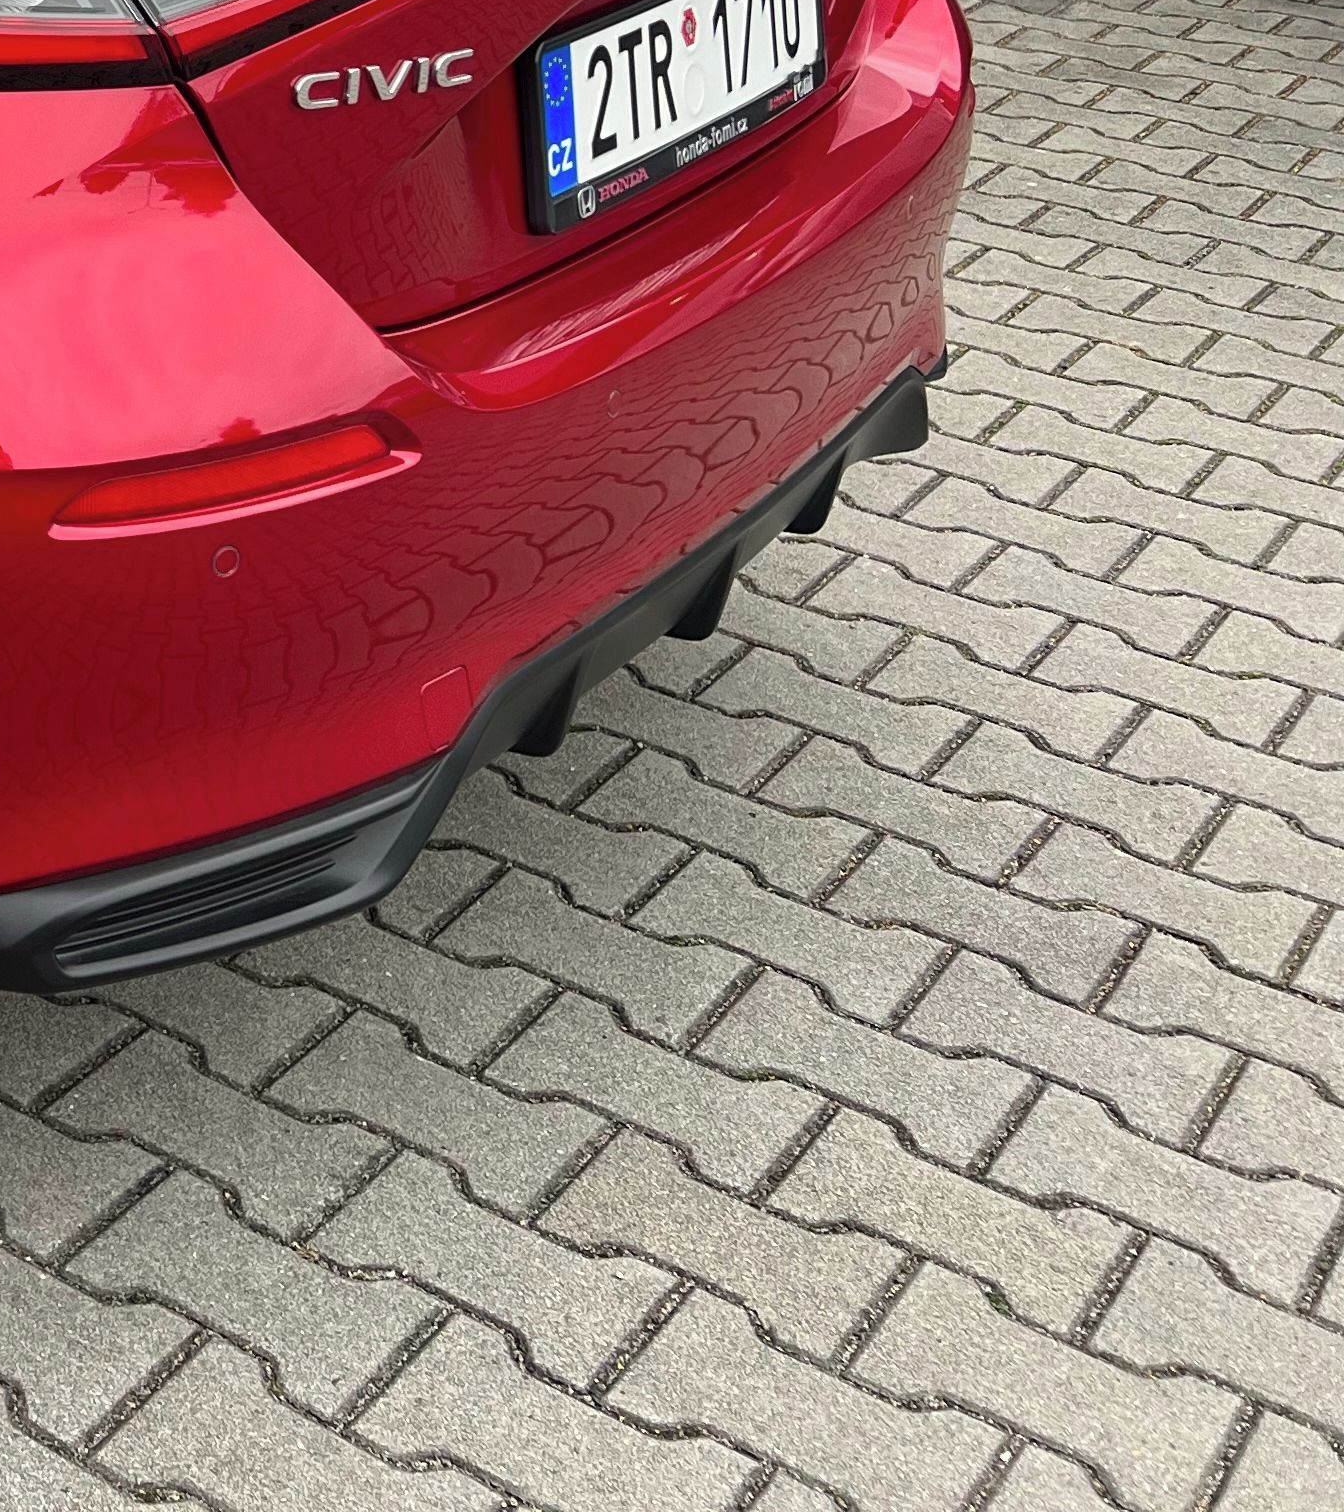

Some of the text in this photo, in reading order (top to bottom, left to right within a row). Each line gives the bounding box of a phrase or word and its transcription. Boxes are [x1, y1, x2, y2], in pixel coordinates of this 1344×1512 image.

[293, 48, 474, 110] CIVIC
[587, 19, 677, 159] 2TR
[547, 138, 573, 177] CZ
[598, 167, 649, 203] HONDA
[675, 117, 749, 168] honda-fomi.cz
